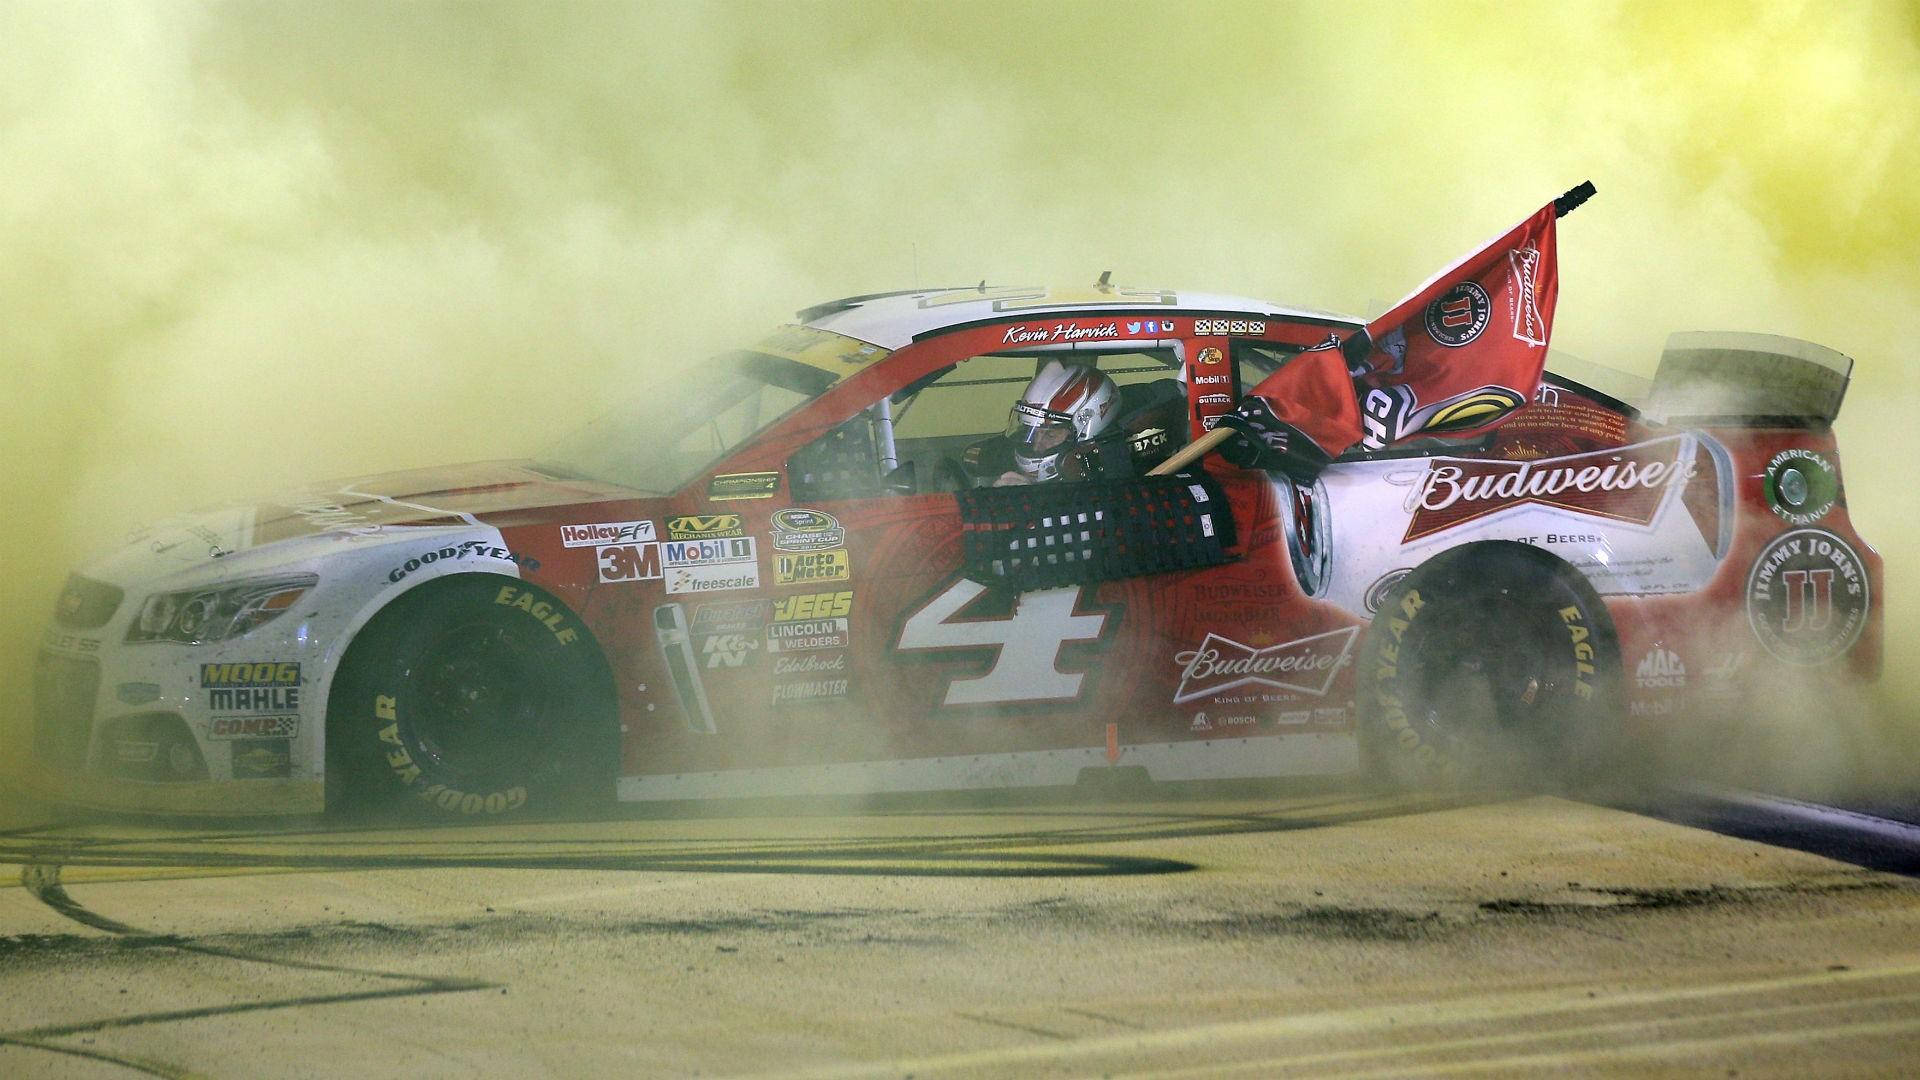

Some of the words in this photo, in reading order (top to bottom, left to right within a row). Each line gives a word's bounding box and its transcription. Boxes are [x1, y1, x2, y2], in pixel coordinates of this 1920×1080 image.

[1003, 327, 1048, 343] Kevin
[1195, 376, 1219, 384] Mobil
[1768, 449, 1832, 477] AMERICAN
[1383, 456, 1698, 514] Budweiser
[1772, 500, 1834, 525] ETHANOL
[563, 526, 620, 542] Holley
[670, 531, 716, 541] MECHANIX
[716, 528, 744, 538] WEAR
[780, 537, 817, 545] SPRINT
[388, 541, 541, 584] GOODYEAR
[601, 543, 661, 581] 3M
[667, 540, 726, 562] Mobil
[796, 553, 835, 566] Auto
[1754, 539, 1802, 601] JIMMY
[1808, 538, 1862, 596] JOHN'S
[692, 574, 755, 590] freescale
[497, 585, 579, 646] EAGLE
[774, 591, 853, 621] JEGS
[771, 621, 833, 638] LINCOLN
[785, 636, 840, 649] WELDERS
[897, 577, 1106, 706] 4
[1558, 605, 1595, 699] EAGLE
[203, 663, 299, 684] MOOG
[775, 654, 845, 675] Edelbrock
[1174, 648, 1353, 680] Budweiser
[1635, 648, 1686, 677] MAC
[210, 688, 299, 710] MAHLE
[773, 680, 848, 705] FLOWMASTER
